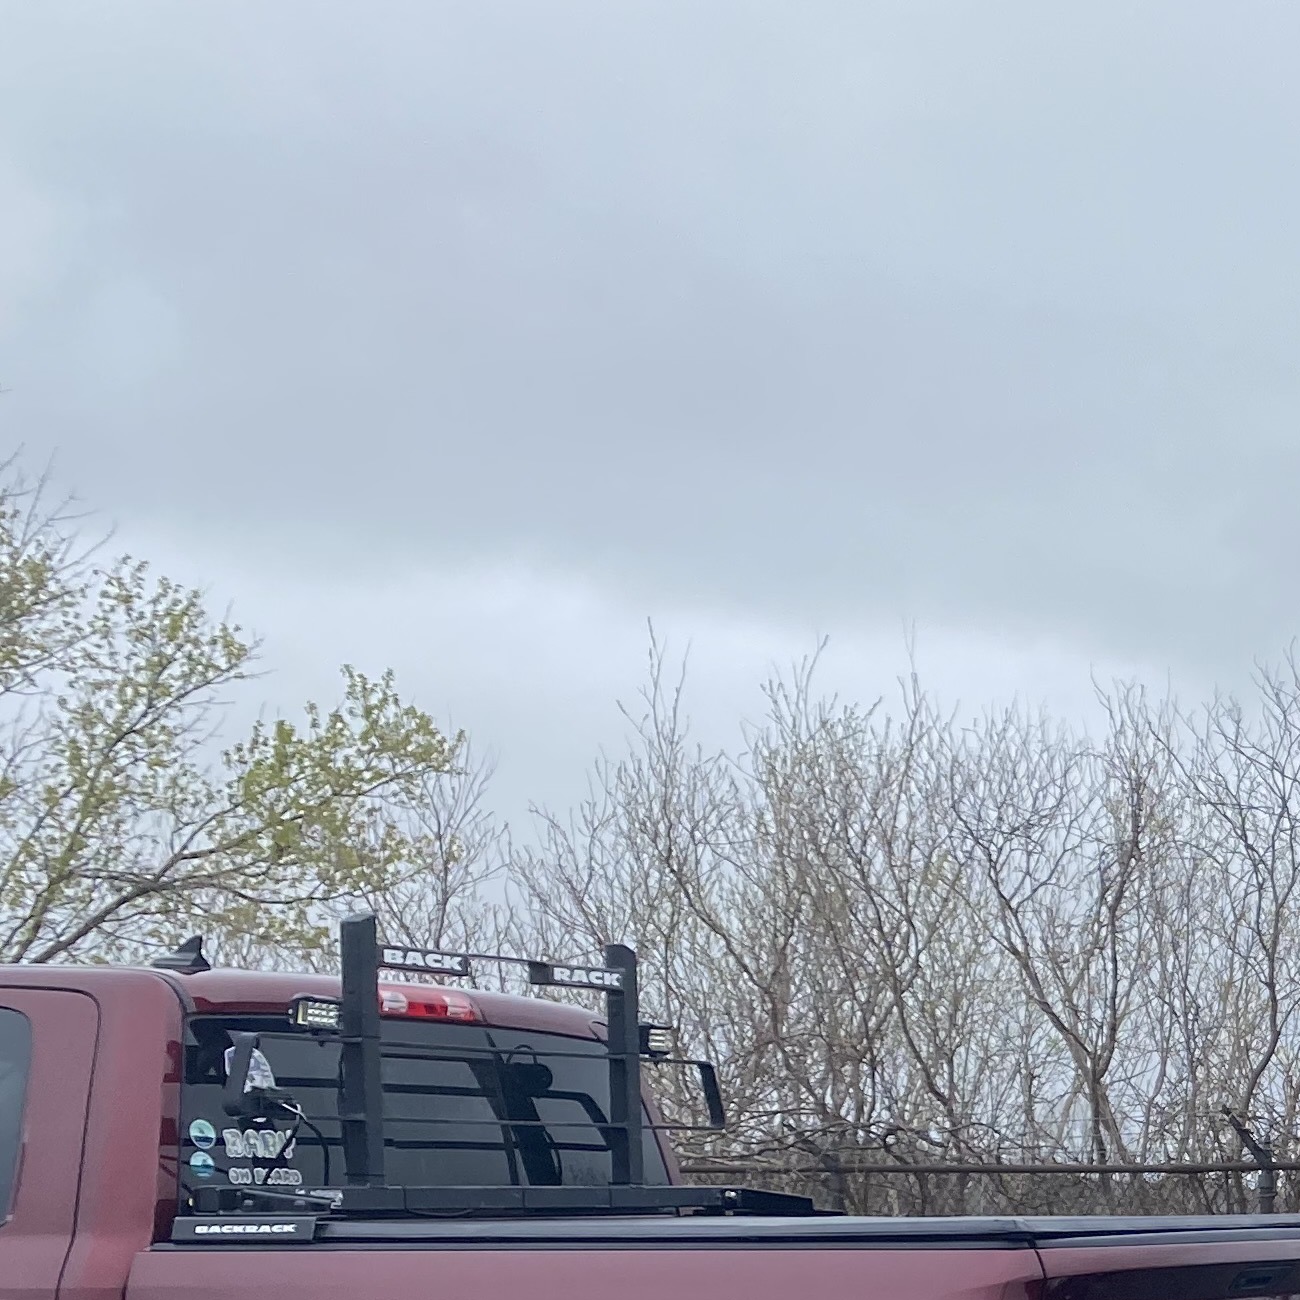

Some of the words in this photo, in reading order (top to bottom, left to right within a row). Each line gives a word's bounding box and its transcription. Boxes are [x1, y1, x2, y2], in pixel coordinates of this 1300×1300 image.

[382, 949, 463, 971] BACK
[553, 967, 620, 986] RACK
[253, 1167, 302, 1185] BARD
